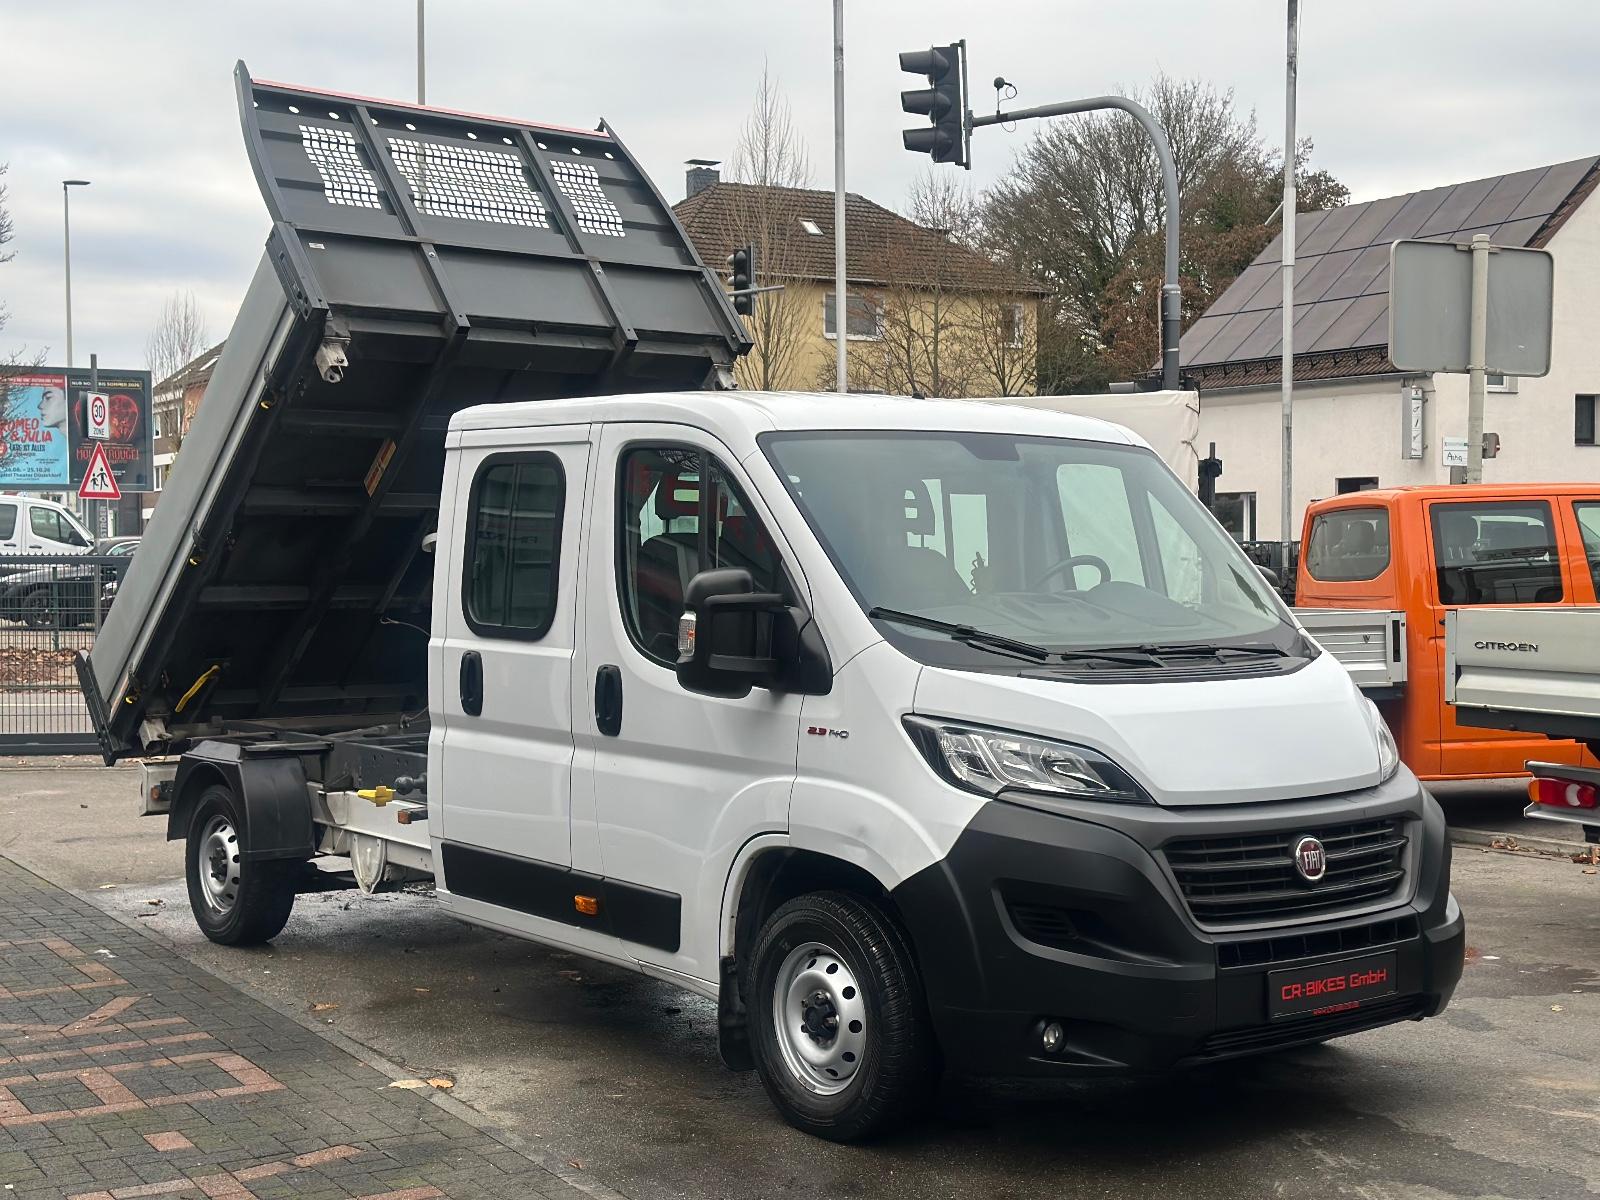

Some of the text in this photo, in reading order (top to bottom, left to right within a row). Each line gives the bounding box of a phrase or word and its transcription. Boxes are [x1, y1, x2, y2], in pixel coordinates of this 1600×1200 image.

[94, 404, 103, 419] 30
[20, 429, 53, 443] JULIA
[93, 427, 104, 436] ZONE
[828, 729, 850, 739] 140
[1303, 850, 1321, 870] FIAT
[1281, 968, 1387, 1000] CR-BIKES GmbH
